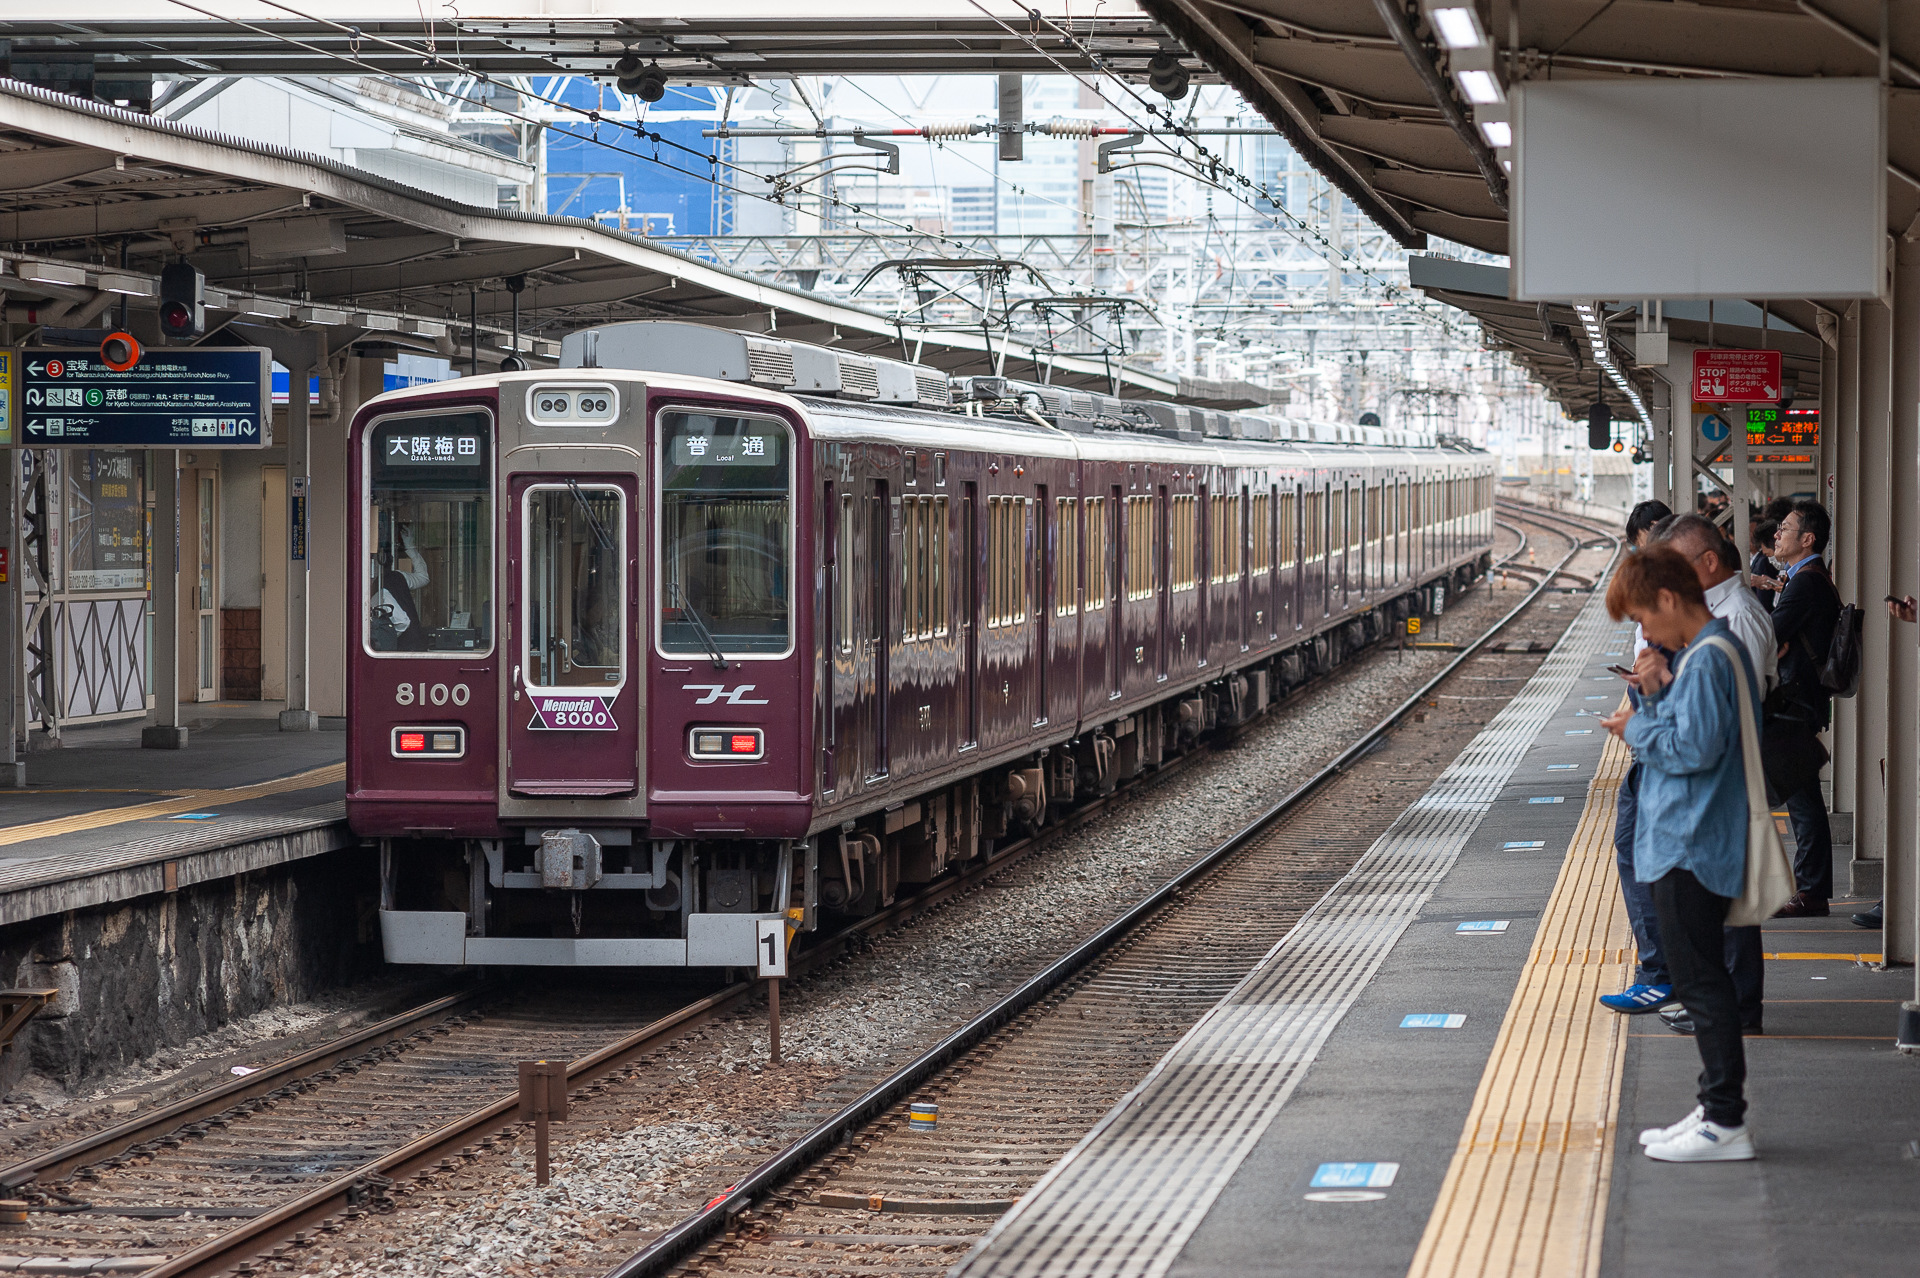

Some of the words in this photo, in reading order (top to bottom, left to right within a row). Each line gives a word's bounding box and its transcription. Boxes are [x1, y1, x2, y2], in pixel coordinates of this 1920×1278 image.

[51, 363, 59, 374] 3
[66, 360, 88, 371] 宝塚
[1699, 368, 1726, 377] STOP
[91, 392, 98, 402] 5
[105, 389, 127, 400] 京都
[1749, 410, 1777, 421] 12:53
[1710, 418, 1719, 437] 1
[389, 436, 476, 456] 大阪梅田
[1409, 620, 1419, 632] S
[395, 682, 471, 707] 8100
[541, 698, 595, 712] Memorial
[555, 711, 607, 726] 8000
[760, 932, 776, 966] 1
